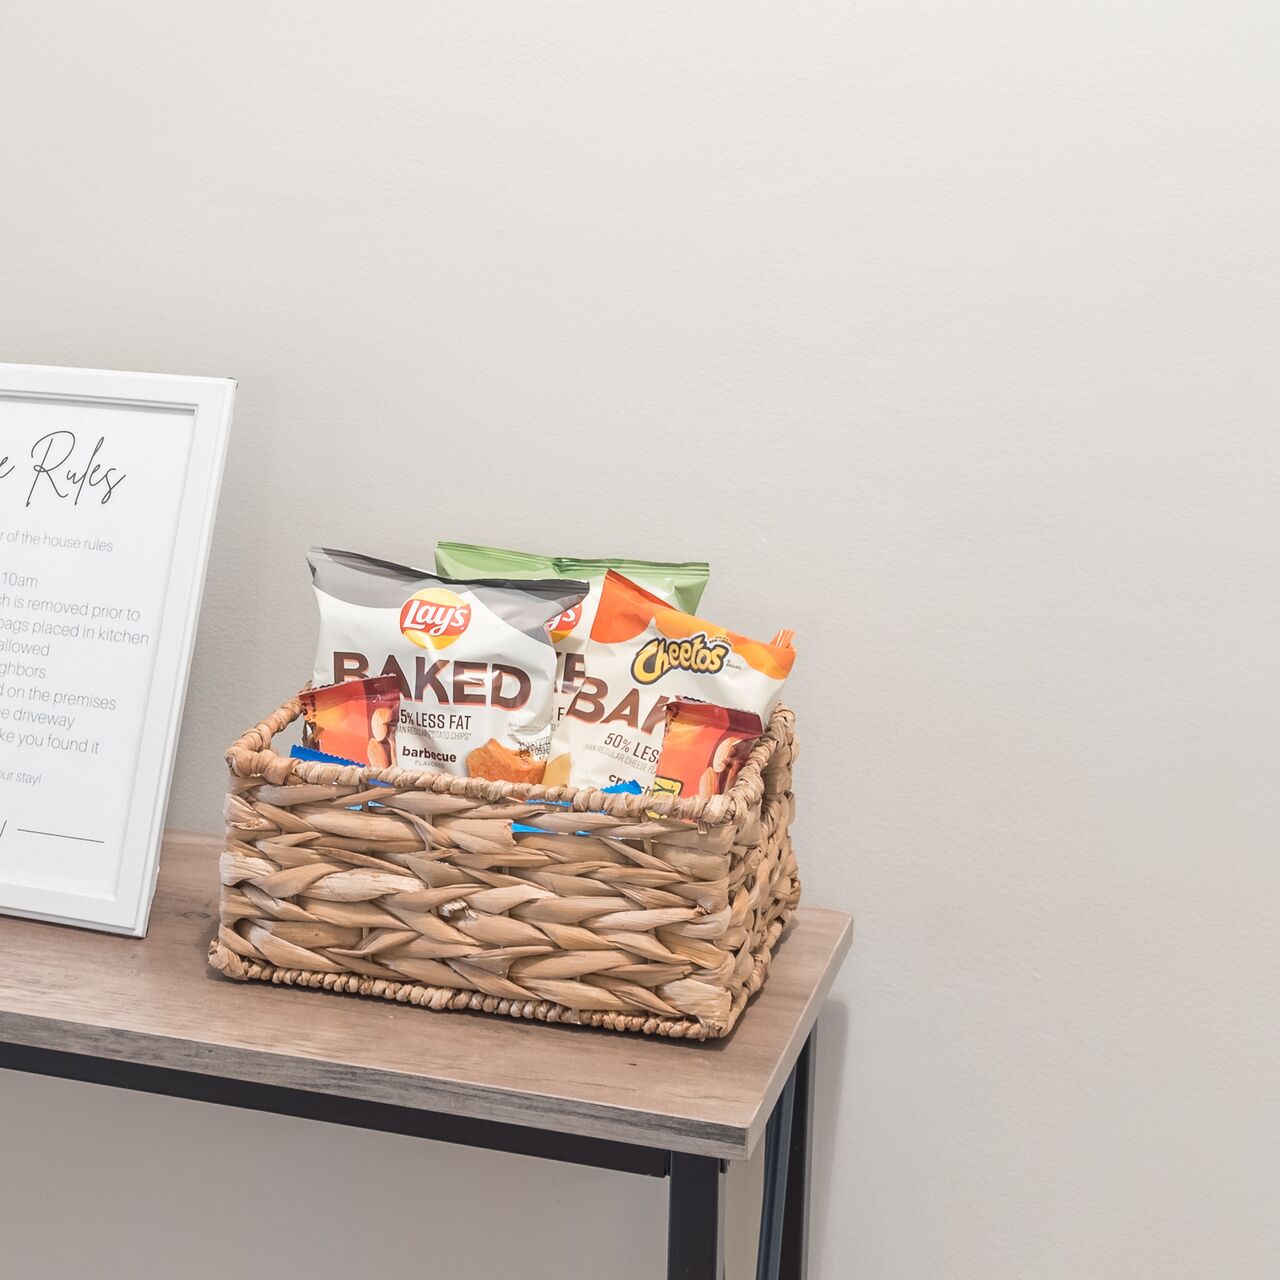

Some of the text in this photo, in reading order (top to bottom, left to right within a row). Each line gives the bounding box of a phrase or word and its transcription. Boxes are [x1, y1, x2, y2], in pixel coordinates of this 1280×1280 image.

[26, 430, 127, 507] Rules
[6, 529, 21, 543] of
[21, 532, 41, 545] the
[43, 533, 81, 550] house
[84, 537, 114, 552] rules
[2, 571, 38, 588] 10am
[13, 595, 24, 609] is
[27, 598, 89, 616] removed
[91, 606, 123, 619] prior
[127, 609, 141, 622] to
[402, 599, 468, 636] Lay's
[32, 619, 79, 638] placed
[82, 625, 95, 639] in
[98, 627, 150, 645] kitchen
[631, 634, 728, 685] Cheetos
[333, 651, 532, 711] BAKED
[7, 686, 25, 698] on
[28, 686, 50, 702] the
[53, 691, 117, 710] premises
[13, 707, 76, 731] driveway
[400, 709, 471, 730] 5% LESS FAT
[18, 733, 44, 747] you
[47, 733, 89, 752] found
[91, 741, 99, 754] it
[402, 746, 457, 763] barbecue
[604, 732, 660, 764] 50% LES
[16, 771, 42, 786] stay!
